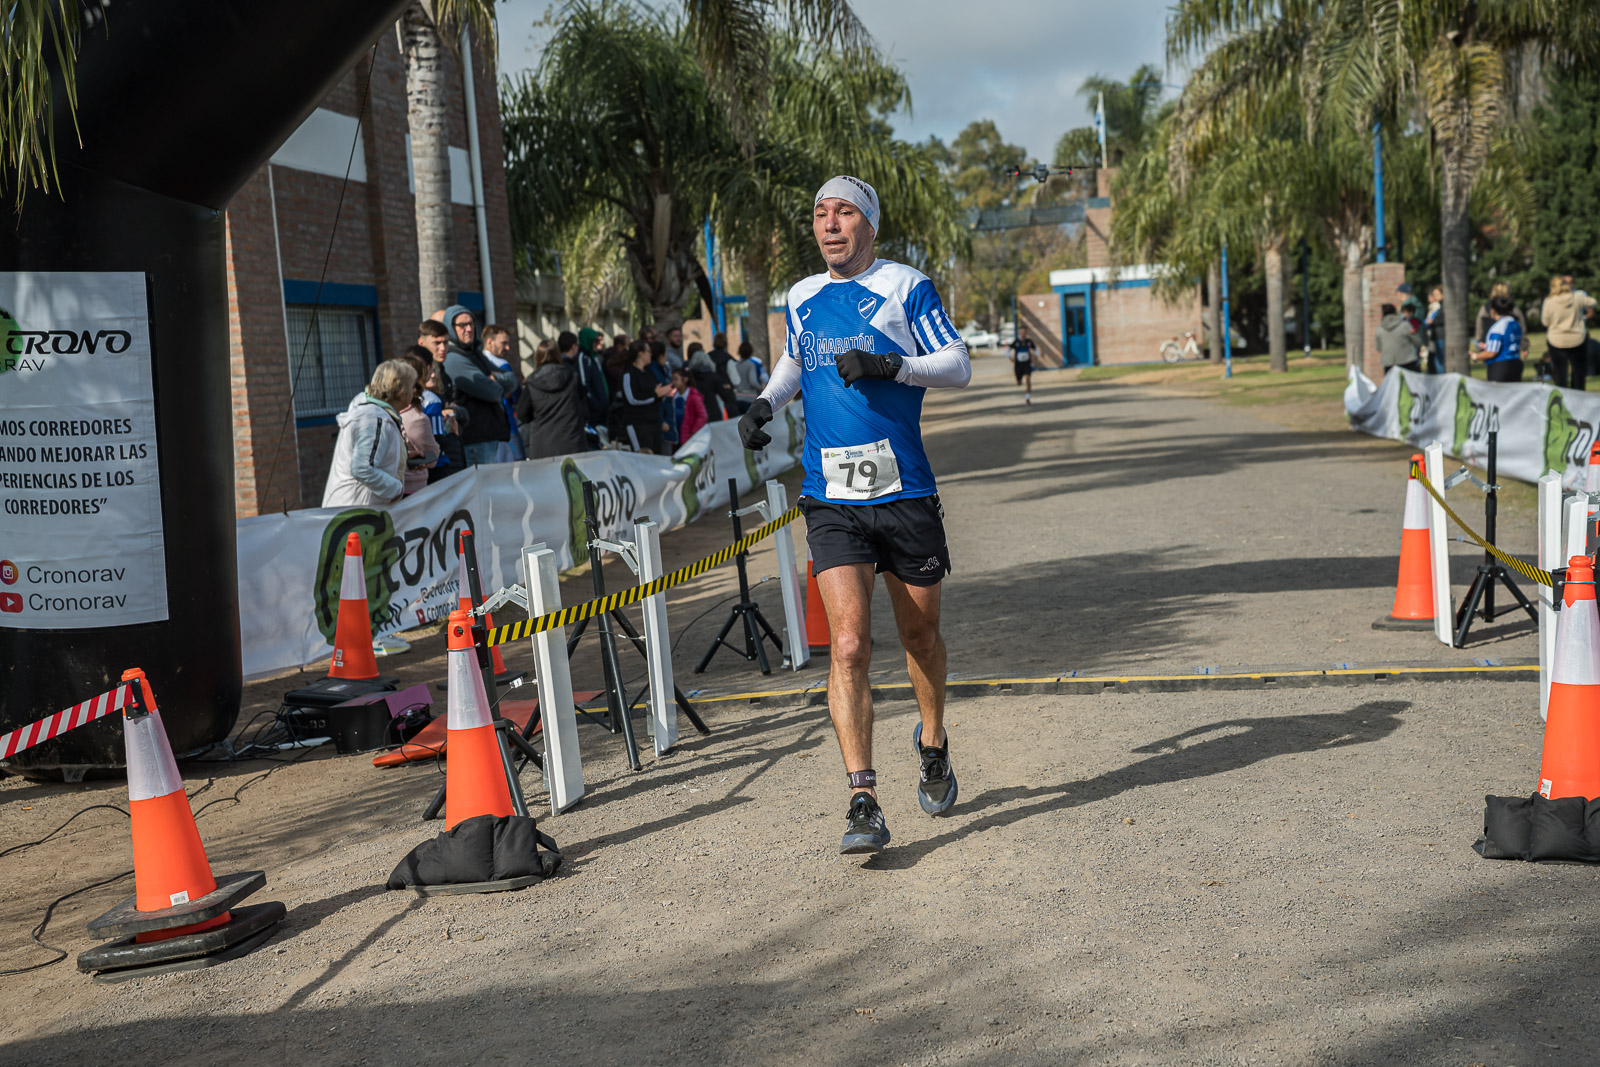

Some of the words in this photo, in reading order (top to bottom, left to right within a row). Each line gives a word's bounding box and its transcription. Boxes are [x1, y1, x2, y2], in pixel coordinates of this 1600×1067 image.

[6, 330, 132, 355] CRONO
[801, 331, 817, 372] 3
[816, 333, 875, 354] MARATÓN
[29, 419, 133, 437] CORREDORES
[41, 446, 116, 463] MEJORAR
[119, 443, 148, 460] LAS
[81, 472, 102, 488] DE
[106, 470, 135, 487] LOS
[838, 460, 878, 488] 79
[27, 565, 126, 584] Cronorav
[29, 592, 128, 611] Cronorav
